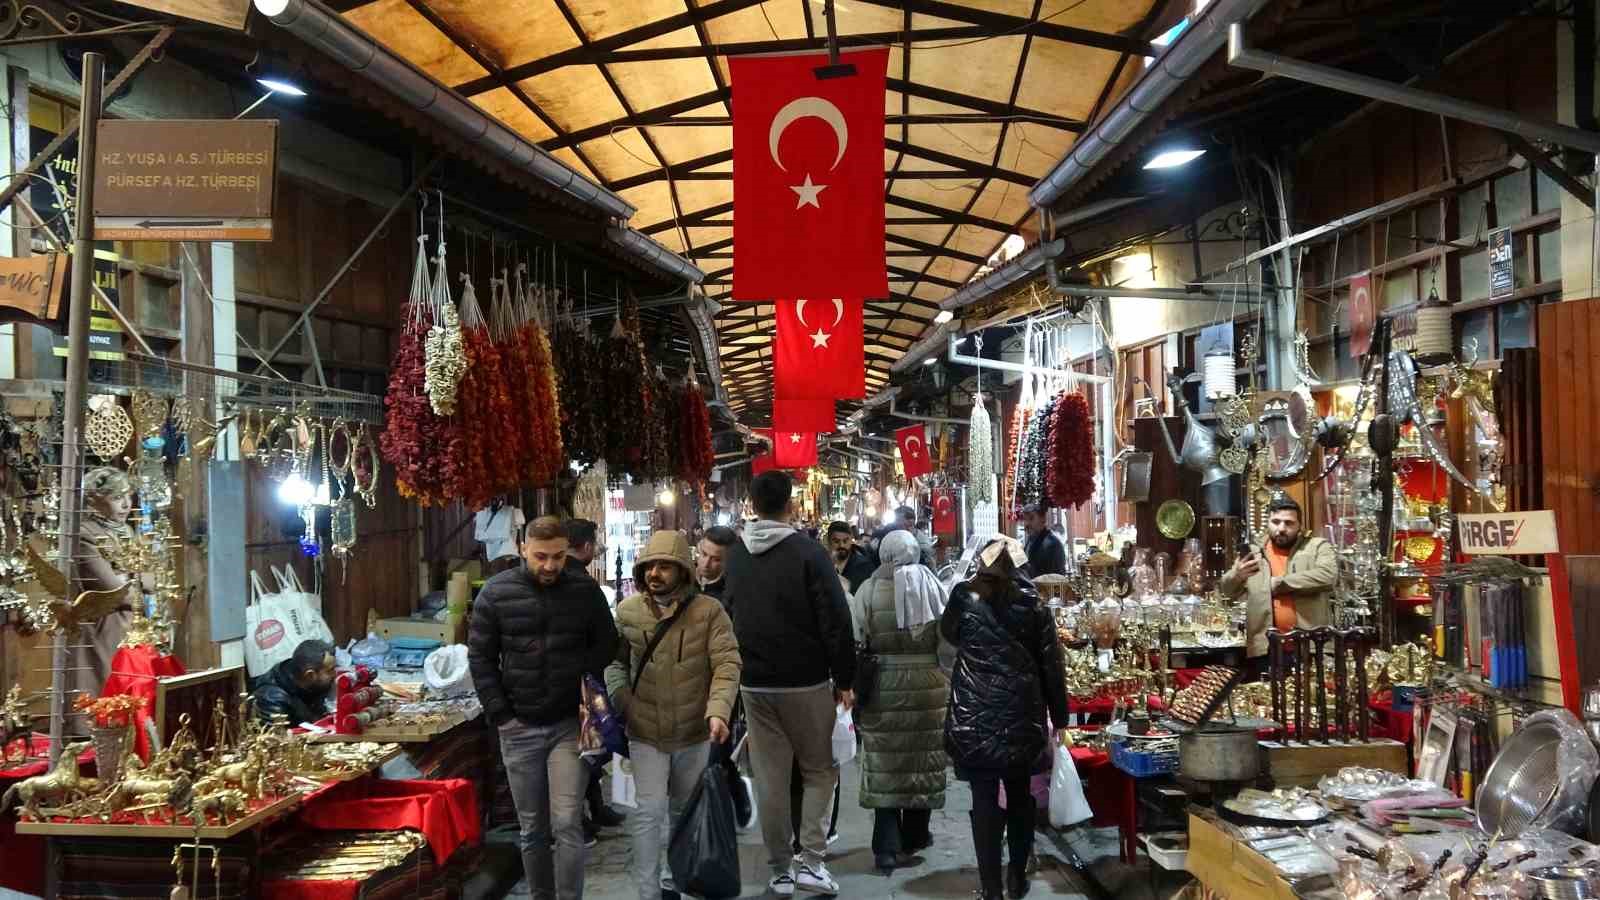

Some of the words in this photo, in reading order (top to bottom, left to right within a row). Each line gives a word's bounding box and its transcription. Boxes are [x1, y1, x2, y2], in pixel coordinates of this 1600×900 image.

[127, 152, 166, 168] YUŞA
[207, 149, 269, 166] TÜRBESİ
[106, 172, 173, 188] PÜRSEFA
[175, 175, 199, 188] HZ.
